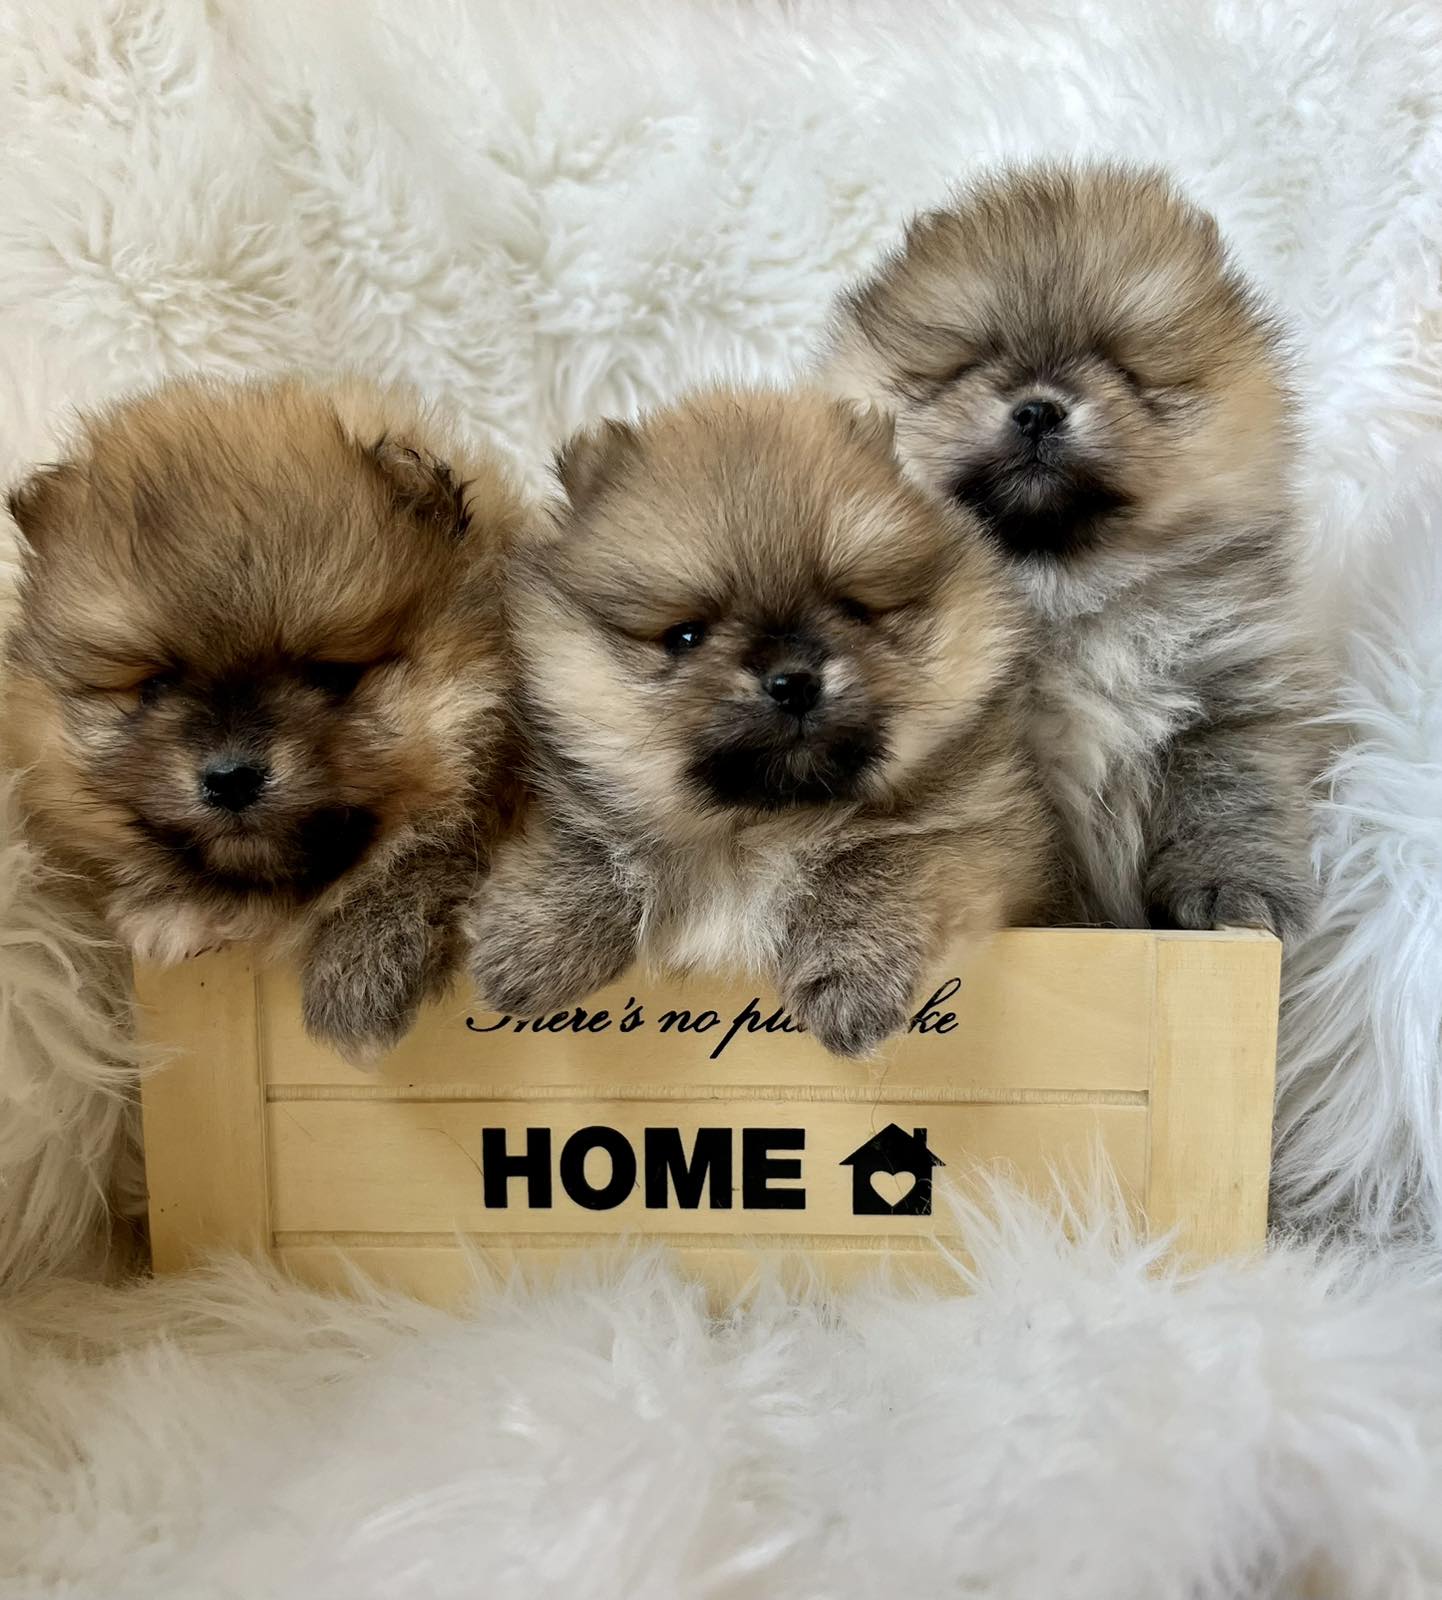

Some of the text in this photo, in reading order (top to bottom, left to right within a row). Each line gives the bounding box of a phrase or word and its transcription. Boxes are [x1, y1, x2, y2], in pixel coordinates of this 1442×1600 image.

[658, 1010, 721, 1033] no
[907, 977, 962, 1034] ke
[482, 1126, 806, 1211] HOME
